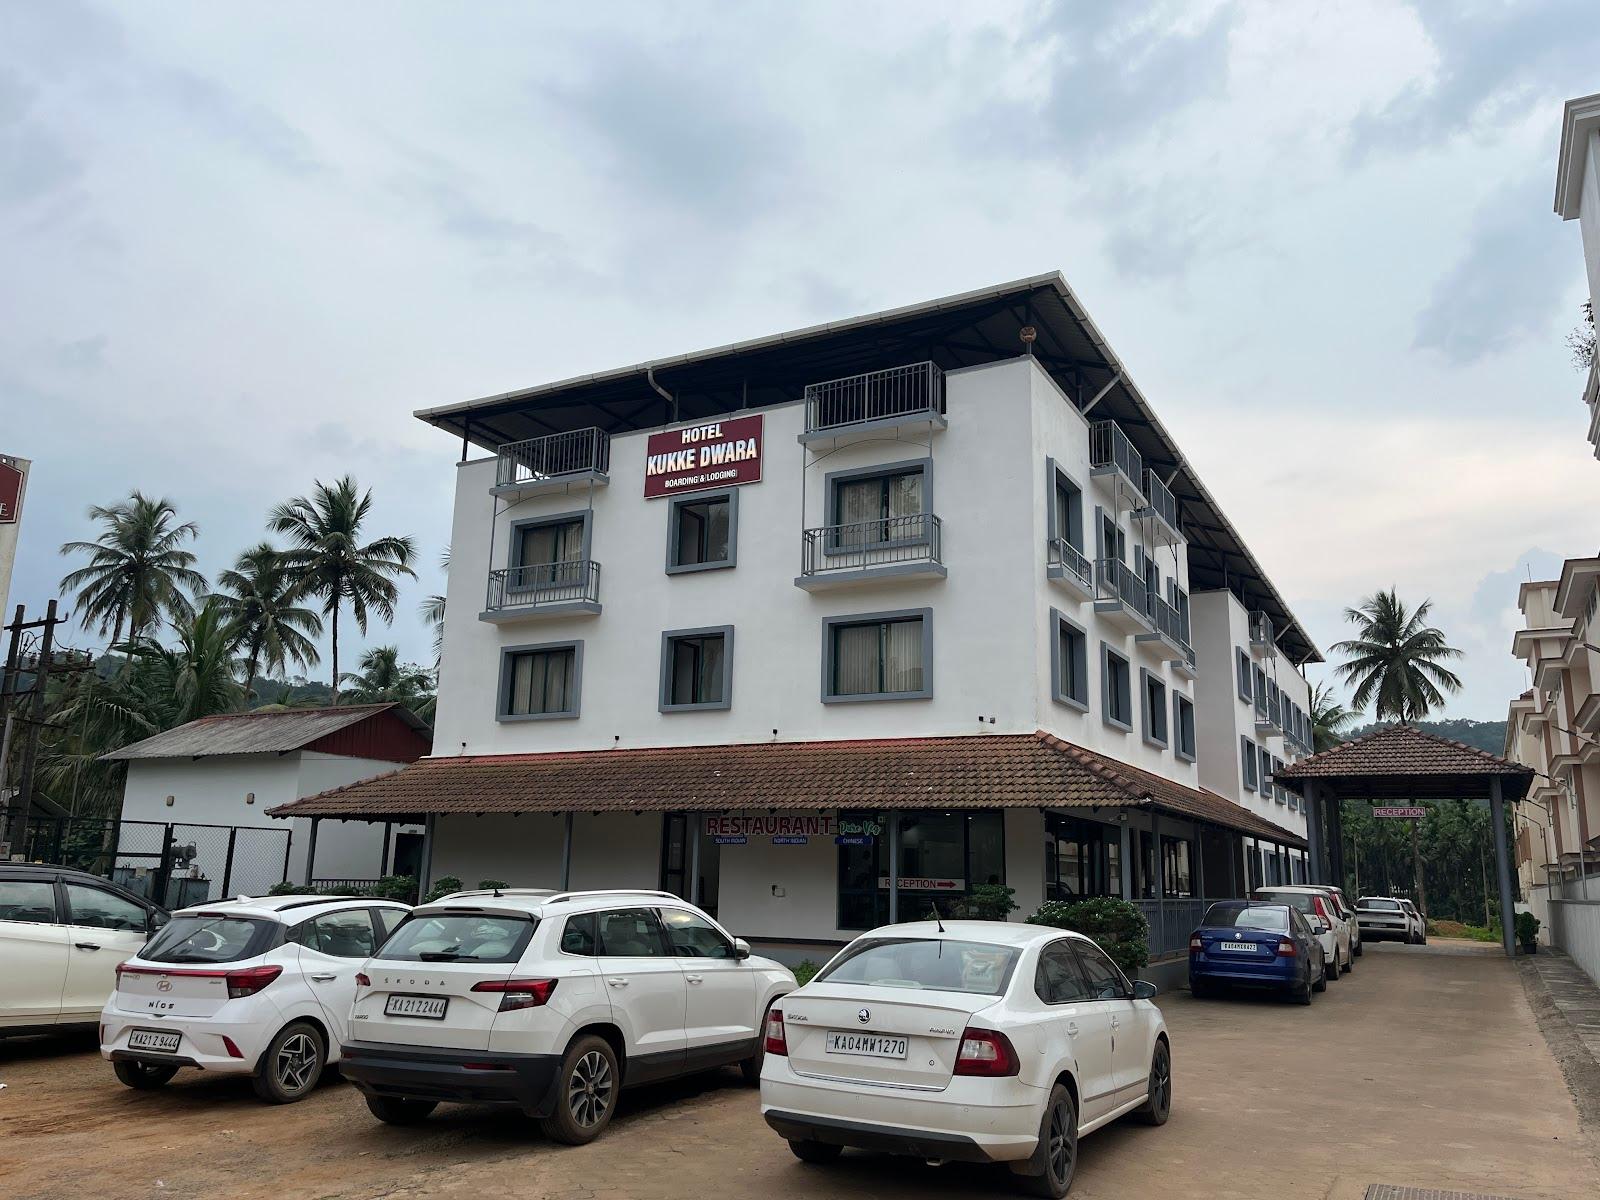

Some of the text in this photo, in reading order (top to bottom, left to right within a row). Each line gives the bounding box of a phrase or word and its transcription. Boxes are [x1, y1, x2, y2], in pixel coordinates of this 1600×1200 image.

[681, 424, 723, 444] HOTEL
[647, 438, 758, 476] KUKKE DWARA
[665, 476, 699, 488] BOARDING
[706, 469, 736, 481] LODGING
[1375, 808, 1425, 816] RECEPTION
[705, 815, 833, 836] RESTAURANT
[885, 880, 936, 889] RCEPTION
[148, 1000, 175, 1009] NIOS
[833, 1035, 905, 1054] KA04MW1270
